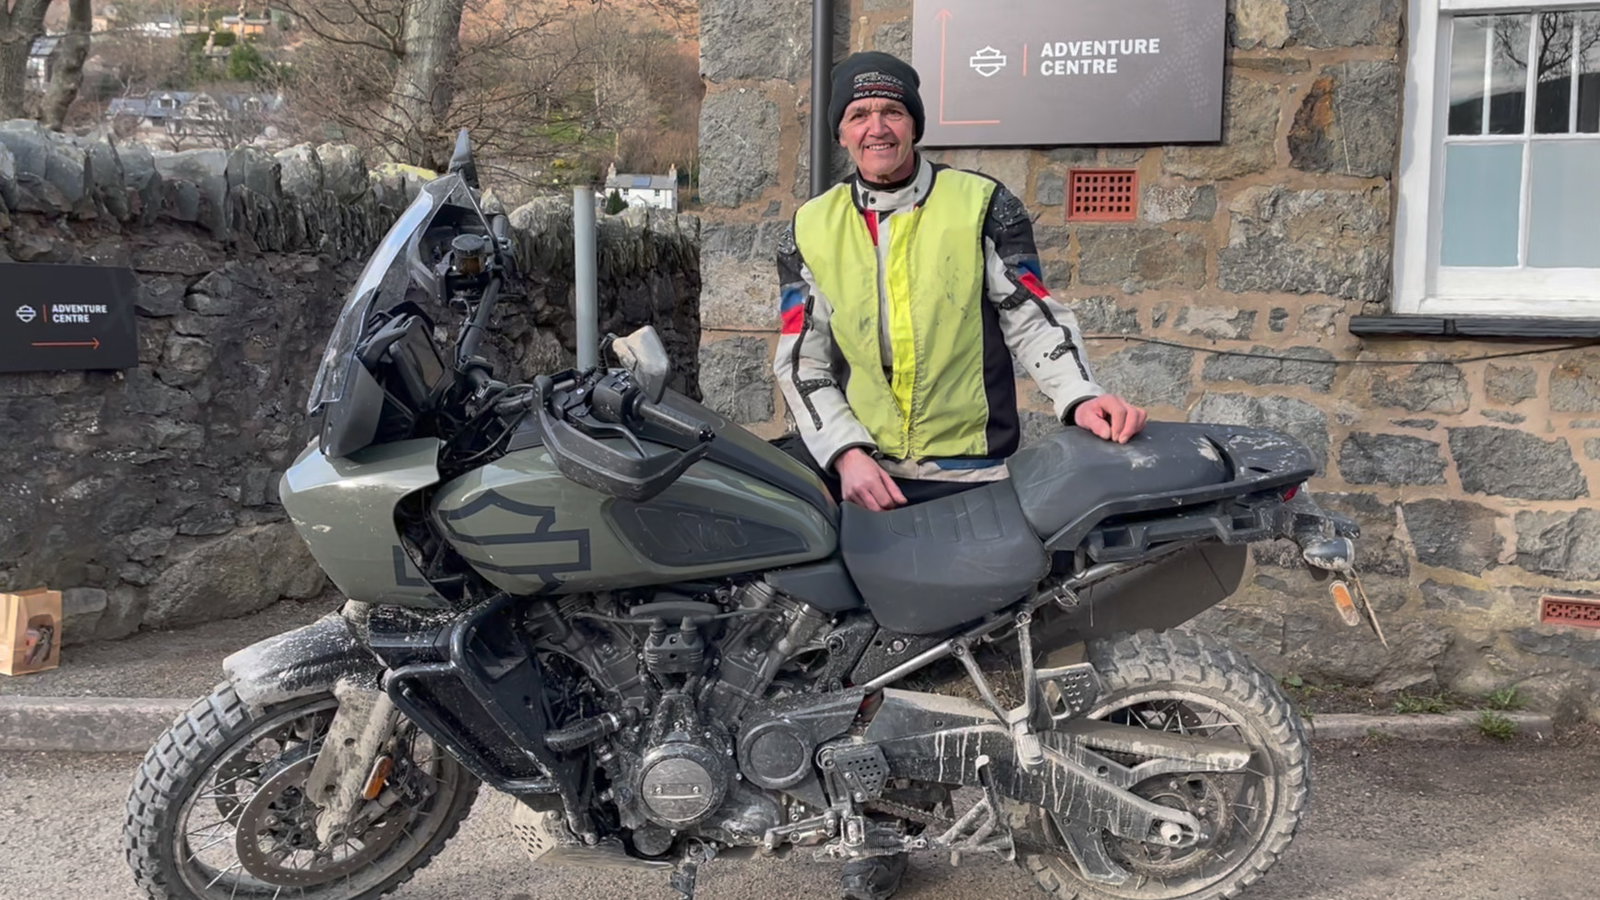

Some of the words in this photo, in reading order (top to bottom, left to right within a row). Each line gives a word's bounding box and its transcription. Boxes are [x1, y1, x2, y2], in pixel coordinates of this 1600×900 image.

[1040, 38, 1160, 57] ADVENTURE
[1040, 58, 1118, 76] CENTRE
[51, 304, 108, 313] ADVENTURE
[52, 314, 90, 323] CENTRE
